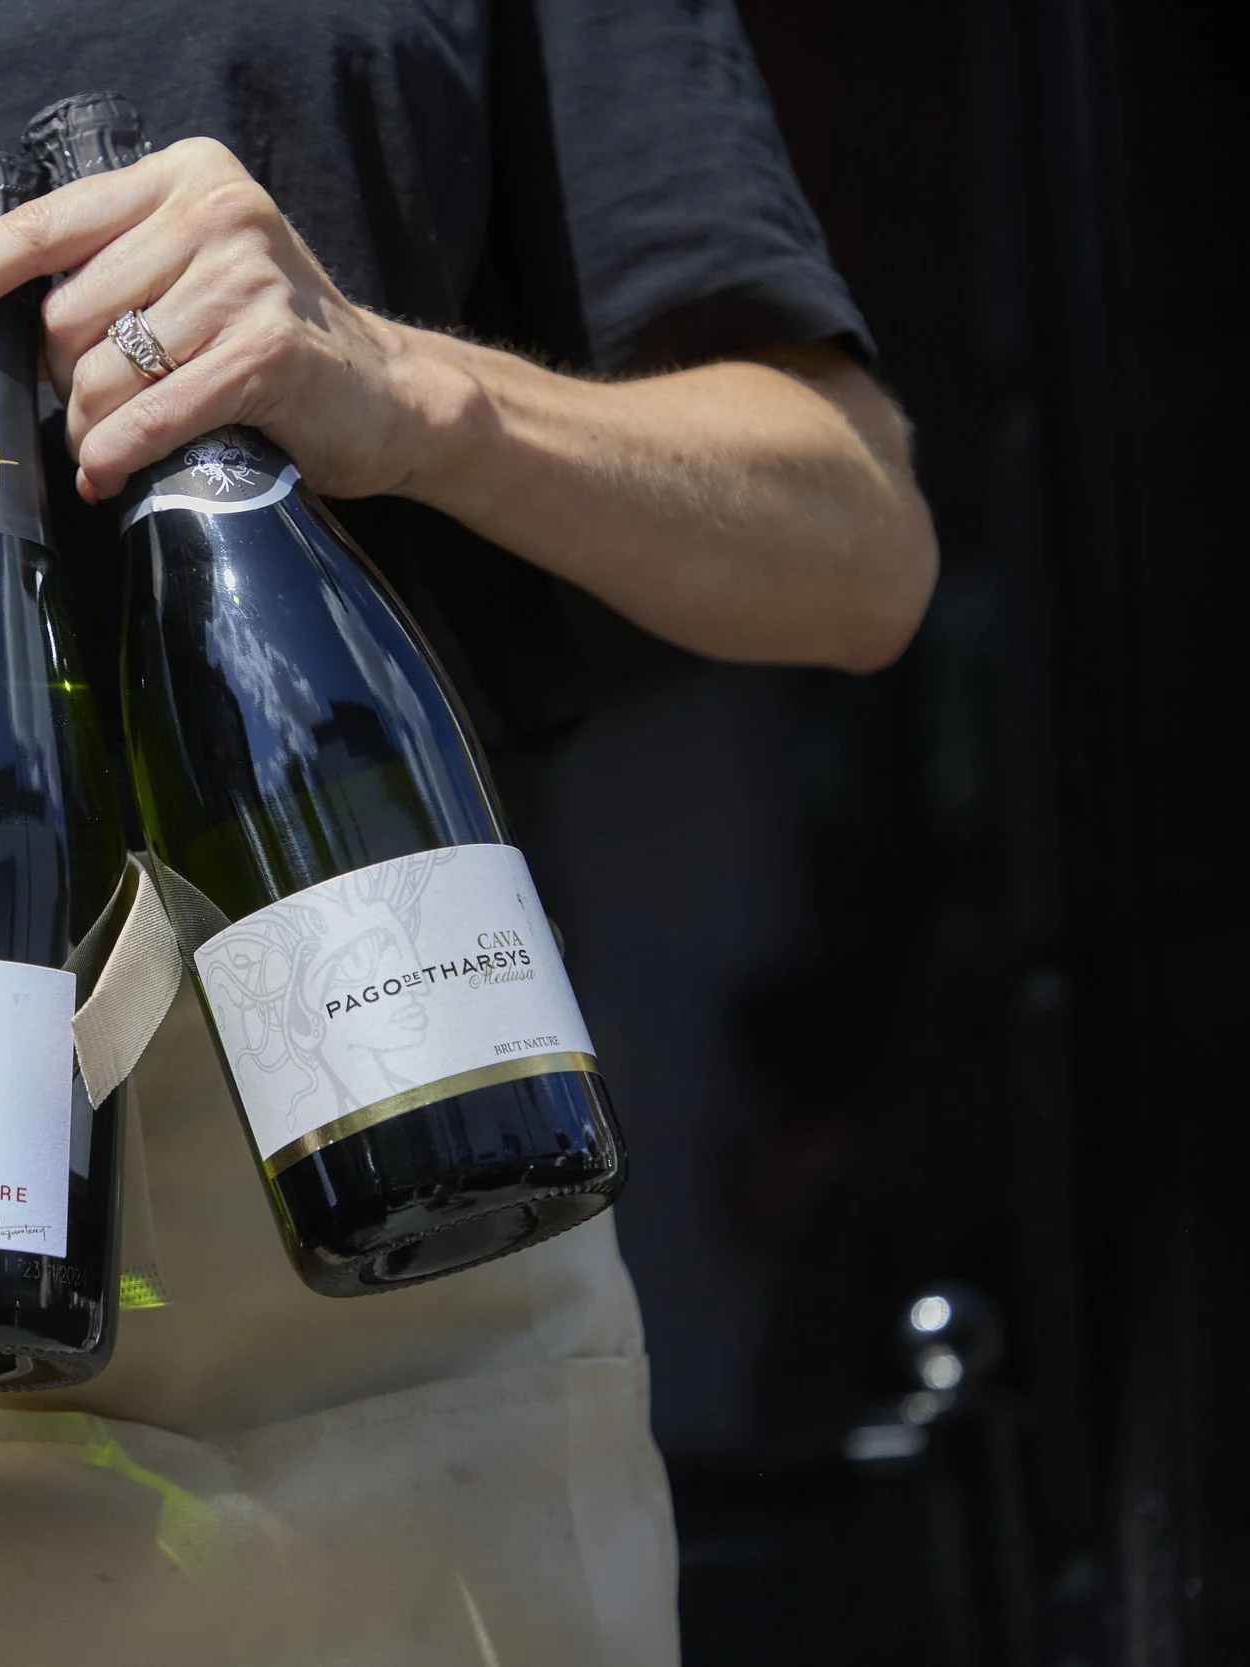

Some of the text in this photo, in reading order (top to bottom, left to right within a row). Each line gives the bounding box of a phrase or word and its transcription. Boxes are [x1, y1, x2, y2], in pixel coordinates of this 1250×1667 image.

[477, 929, 524, 951] CAVA
[325, 949, 532, 1019] PAGO DE THARSYS
[468, 958, 536, 989] Medusa
[493, 1035, 561, 1056] BRUT NATURE
